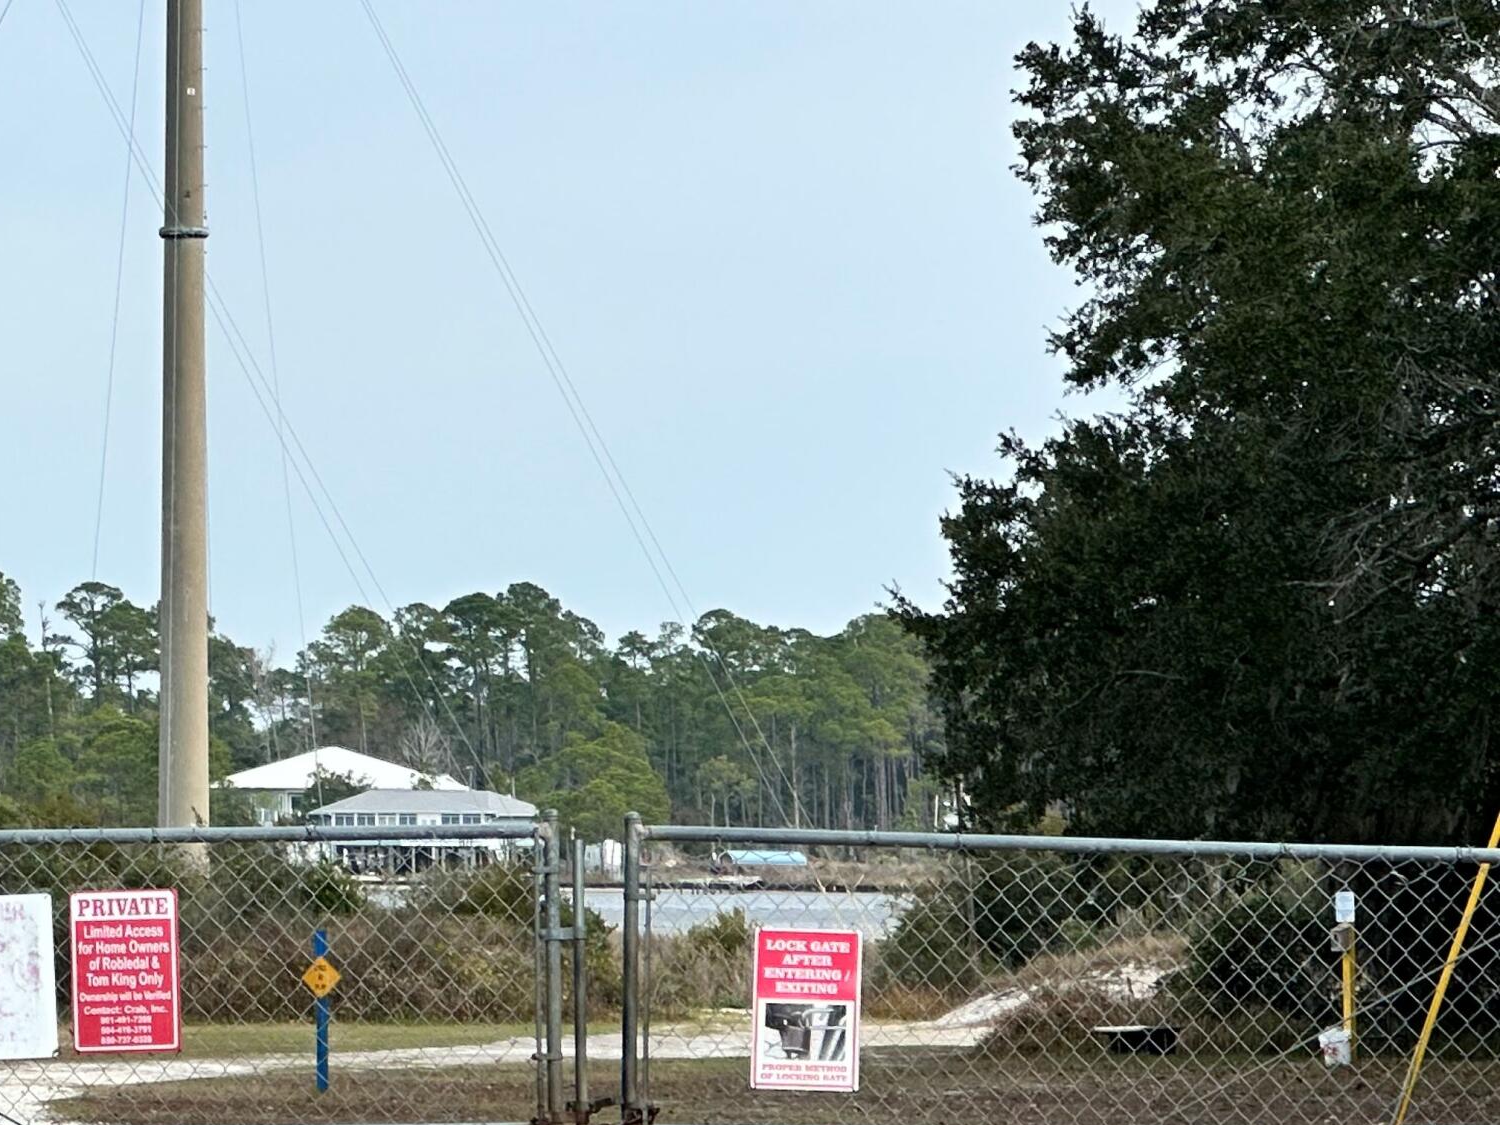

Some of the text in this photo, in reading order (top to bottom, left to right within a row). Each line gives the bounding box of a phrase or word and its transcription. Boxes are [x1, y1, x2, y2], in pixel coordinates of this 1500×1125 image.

[77, 897, 169, 917] PRIVATE
[83, 924, 164, 939] Limited Access
[78, 939, 170, 955] for Home Owners
[766, 939, 851, 954] LOCK GATE
[89, 958, 100, 970] of
[151, 956, 161, 969] &
[783, 955, 833, 967] AFTER
[86, 973, 165, 989] Tom King Only
[764, 967, 842, 981] ENTERING
[775, 982, 838, 995] EXITING
[761, 1063, 848, 1073] PROPER METHOD
[776, 1073, 820, 1081] LOCKING
